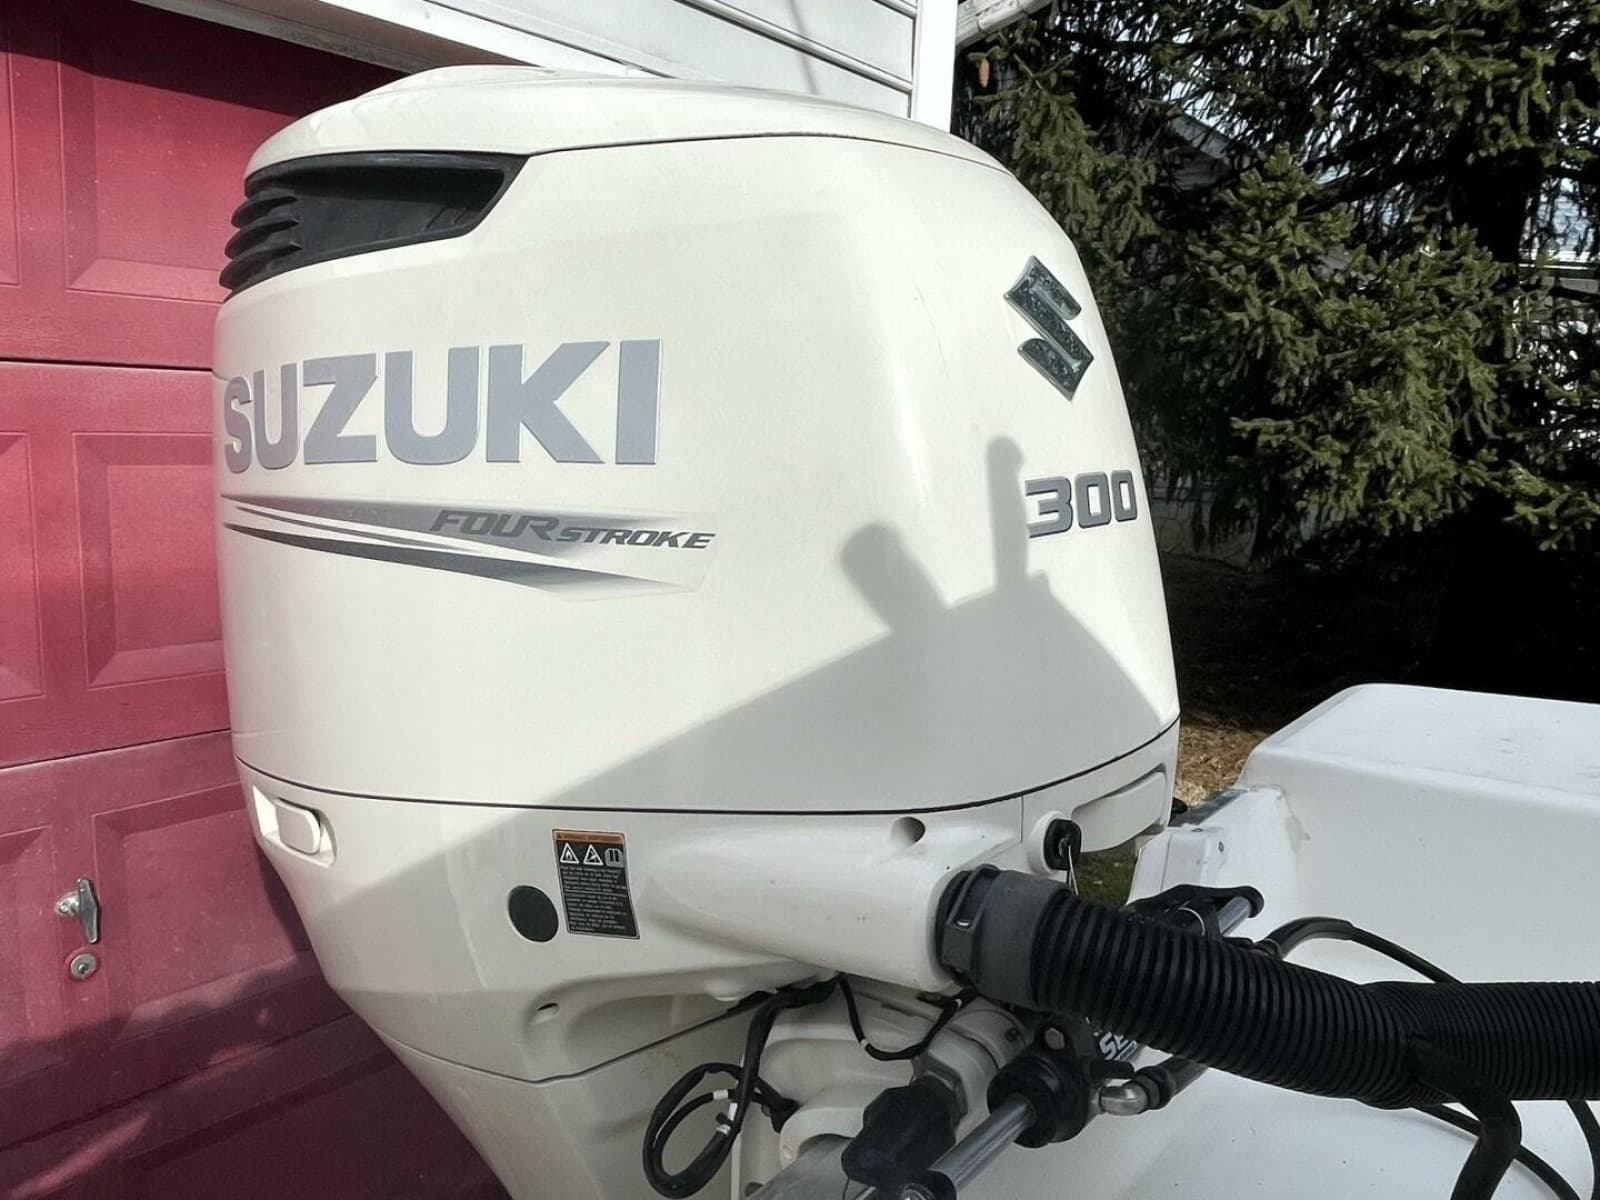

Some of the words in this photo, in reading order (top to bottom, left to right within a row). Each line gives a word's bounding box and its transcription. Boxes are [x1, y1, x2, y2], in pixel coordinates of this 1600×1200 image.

[223, 339, 662, 473] SUZUKI
[429, 510, 559, 541] FOUR
[556, 527, 716, 549] STROKE
[1024, 470, 1138, 538] 300
